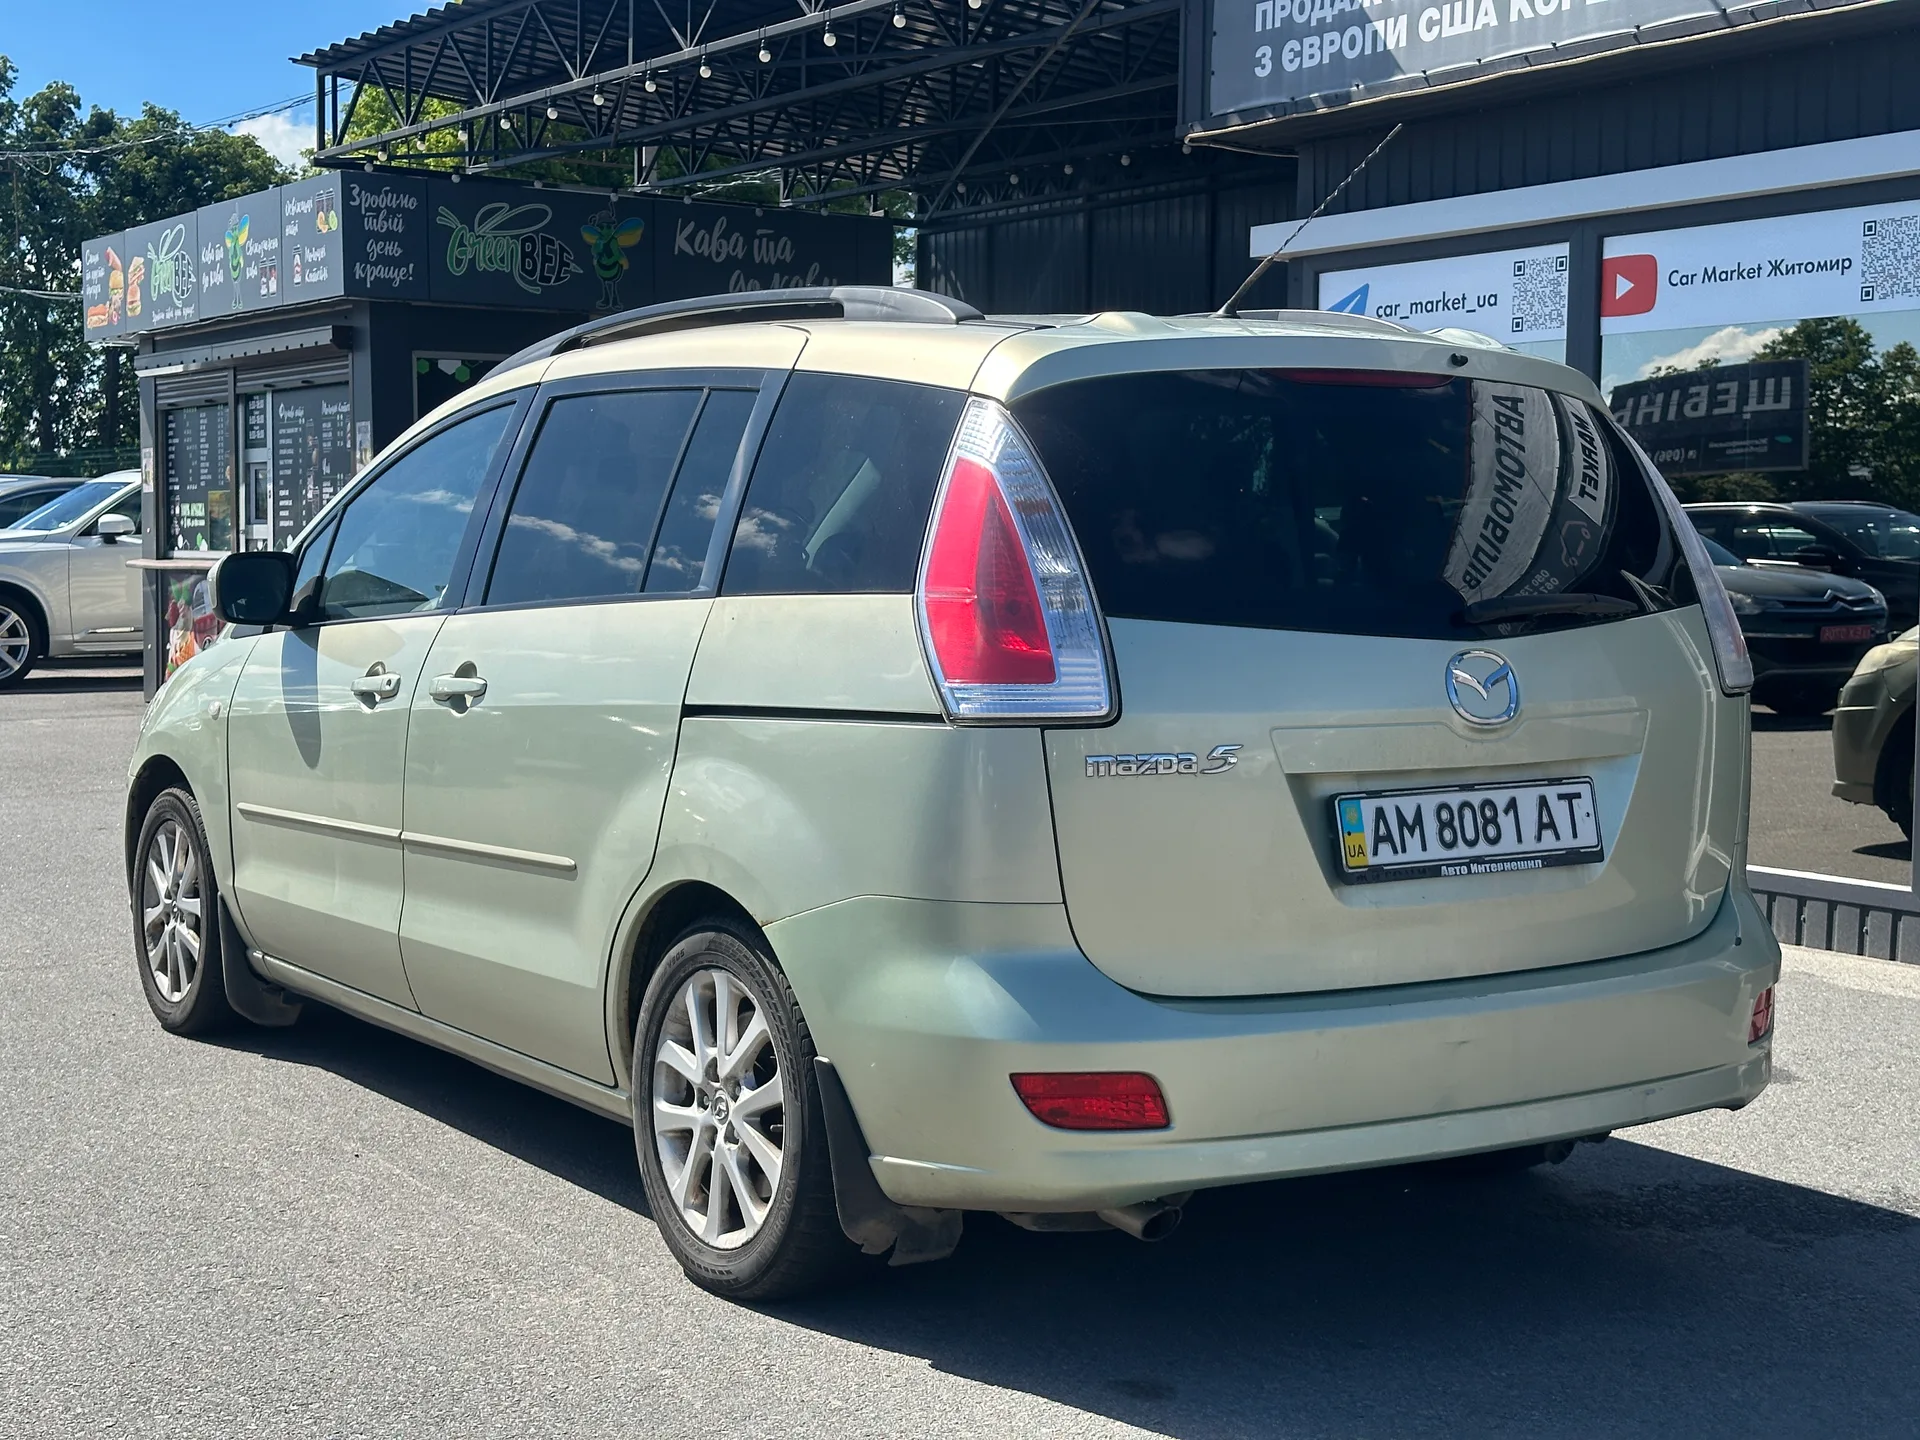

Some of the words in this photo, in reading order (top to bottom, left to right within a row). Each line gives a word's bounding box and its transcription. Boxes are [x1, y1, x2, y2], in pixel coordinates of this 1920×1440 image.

[1254, 46, 1273, 77] З
[1281, 14, 1407, 72] ЄВРОПИ
[1418, 7, 1498, 42] США
[350, 184, 418, 214] Зробимо
[364, 209, 404, 233] твій
[367, 238, 402, 261] день
[675, 216, 747, 263] Кава
[753, 229, 795, 265] та
[354, 262, 414, 288] краще!
[1668, 270, 1697, 287] Car
[1701, 262, 1762, 284] Market
[1767, 257, 1852, 277] Житомир
[1376, 291, 1498, 320] car_market_ua
[1200, 744, 1244, 774] 5
[1371, 803, 1427, 857] AM
[1434, 797, 1523, 850] 8081
[1534, 792, 1582, 843] AT
[1347, 844, 1366, 859] UA
[1440, 864, 1468, 877] Авто
